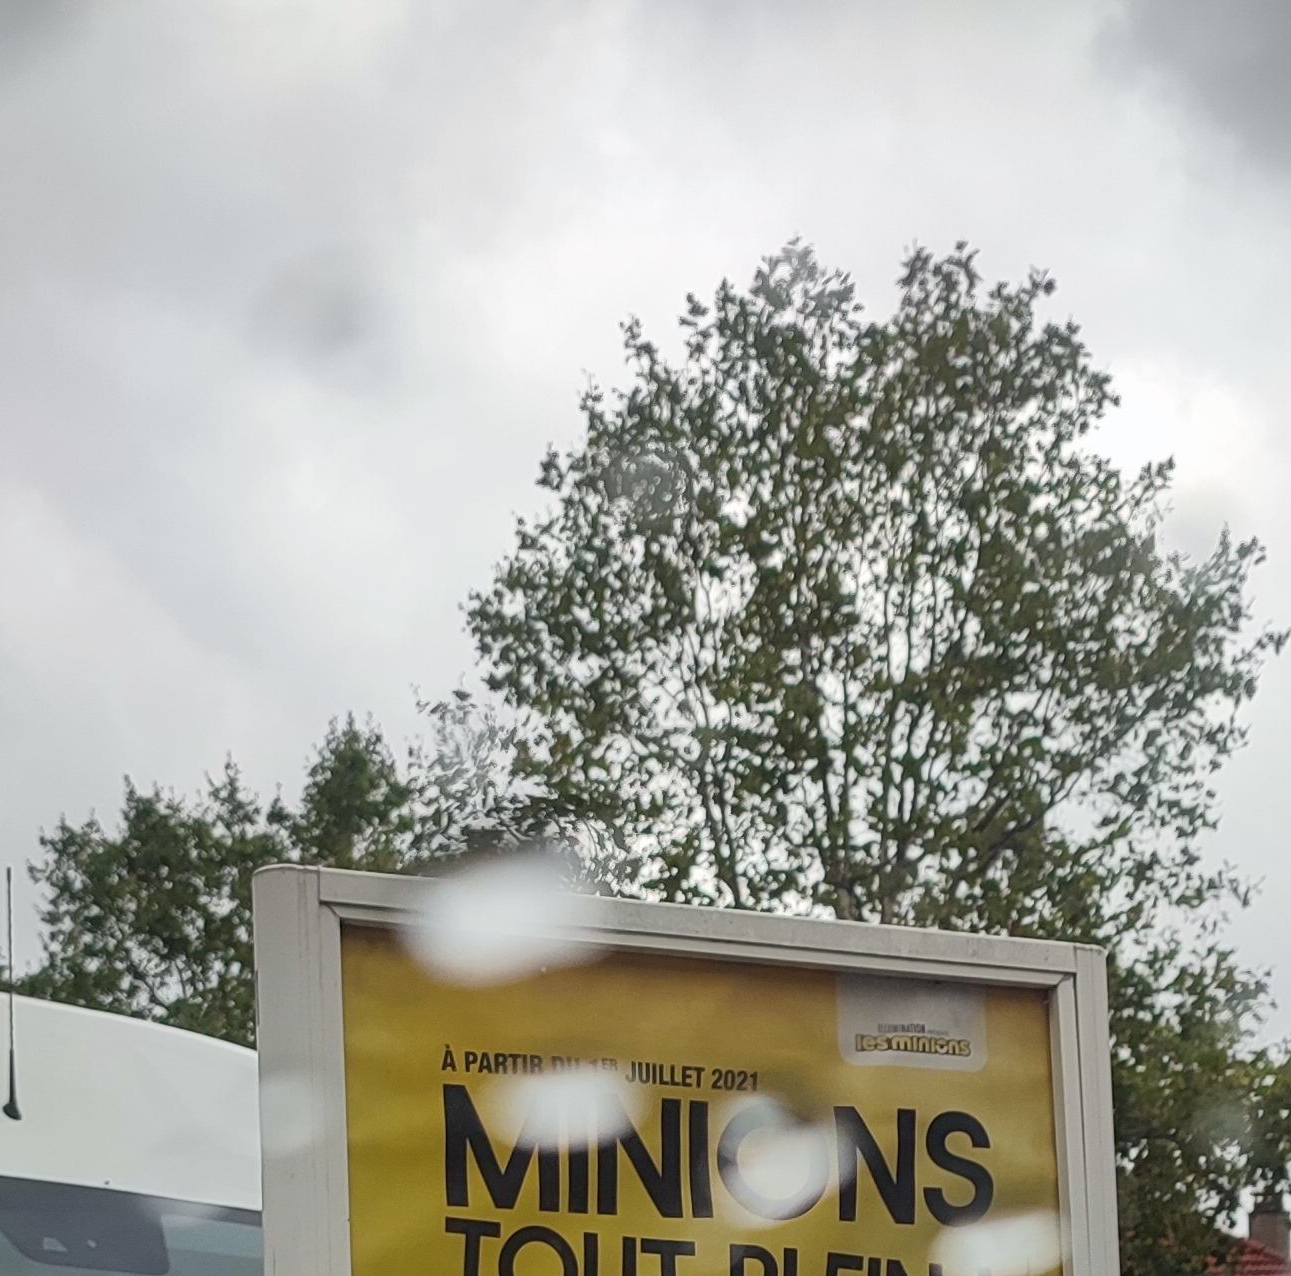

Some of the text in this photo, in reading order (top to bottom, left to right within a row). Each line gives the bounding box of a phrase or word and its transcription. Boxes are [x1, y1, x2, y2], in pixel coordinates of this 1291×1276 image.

[441, 1044, 458, 1072] À
[464, 1050, 544, 1075] PARTIR
[625, 1060, 706, 1089] JUILLET
[711, 1067, 760, 1092] 2021
[855, 1034, 972, 1057] les minions
[442, 1083, 995, 1226] MINIONS
